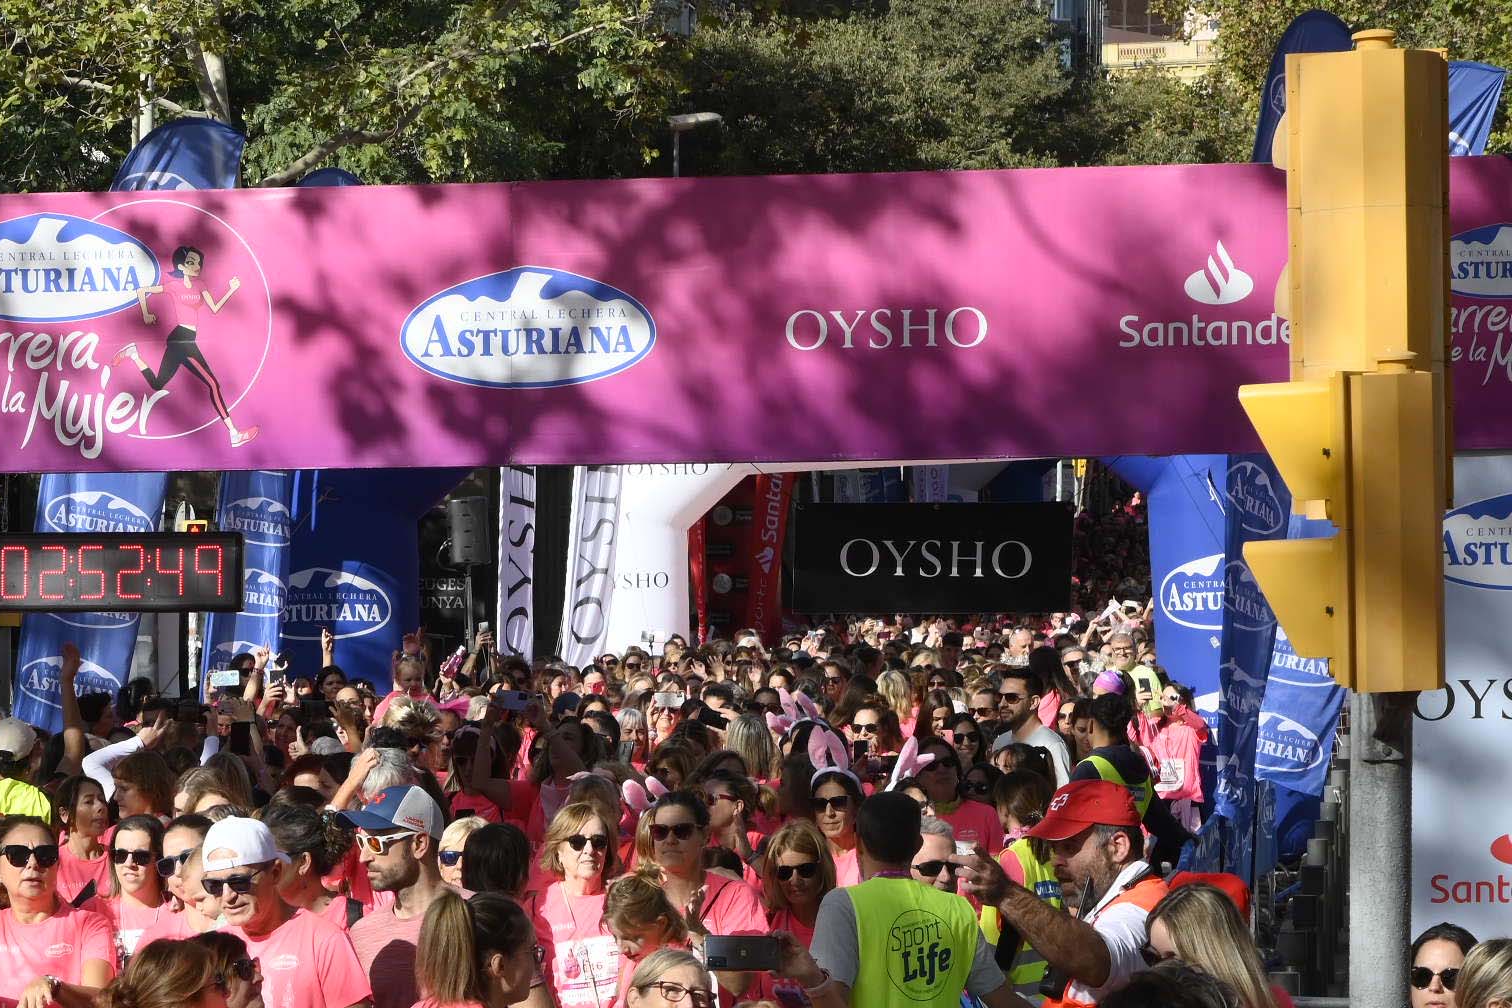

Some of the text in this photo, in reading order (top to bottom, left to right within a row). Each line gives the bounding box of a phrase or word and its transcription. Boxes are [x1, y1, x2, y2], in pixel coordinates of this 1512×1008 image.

[63, 249, 136, 262] LECHERA
[1450, 261, 1512, 280] STUR
[460, 307, 628, 322] CENTRAL LECHERA
[785, 306, 988, 352] OYSHO
[1451, 304, 1512, 334] arre
[420, 314, 637, 358] ASTURIANA
[1119, 314, 1292, 348] Santande
[1451, 339, 1463, 362] e
[1469, 333, 1487, 362] la
[1, 373, 26, 413] la
[20, 364, 171, 459] Mujer
[53, 503, 146, 532] ASTURIANA
[1466, 527, 1512, 537] CENT
[506, 465, 535, 656] OYSH
[571, 465, 618, 645] OYSH
[840, 538, 1033, 579] OYSHO
[1443, 530, 1512, 566] ASTU
[0, 545, 224, 600] 02:52:49
[614, 571, 669, 589] YSHO
[1184, 580, 1225, 589] CENTRA
[289, 592, 324, 601] ENTRAL
[420, 596, 465, 609] UNYA
[1167, 583, 1225, 612] ASTU
[283, 602, 381, 622] STURIANA
[1412, 679, 1512, 722] OYS
[1256, 737, 1313, 765] URIANA
[1431, 873, 1512, 904] Sant
[891, 918, 943, 952] Sport
[902, 942, 952, 986] Life
